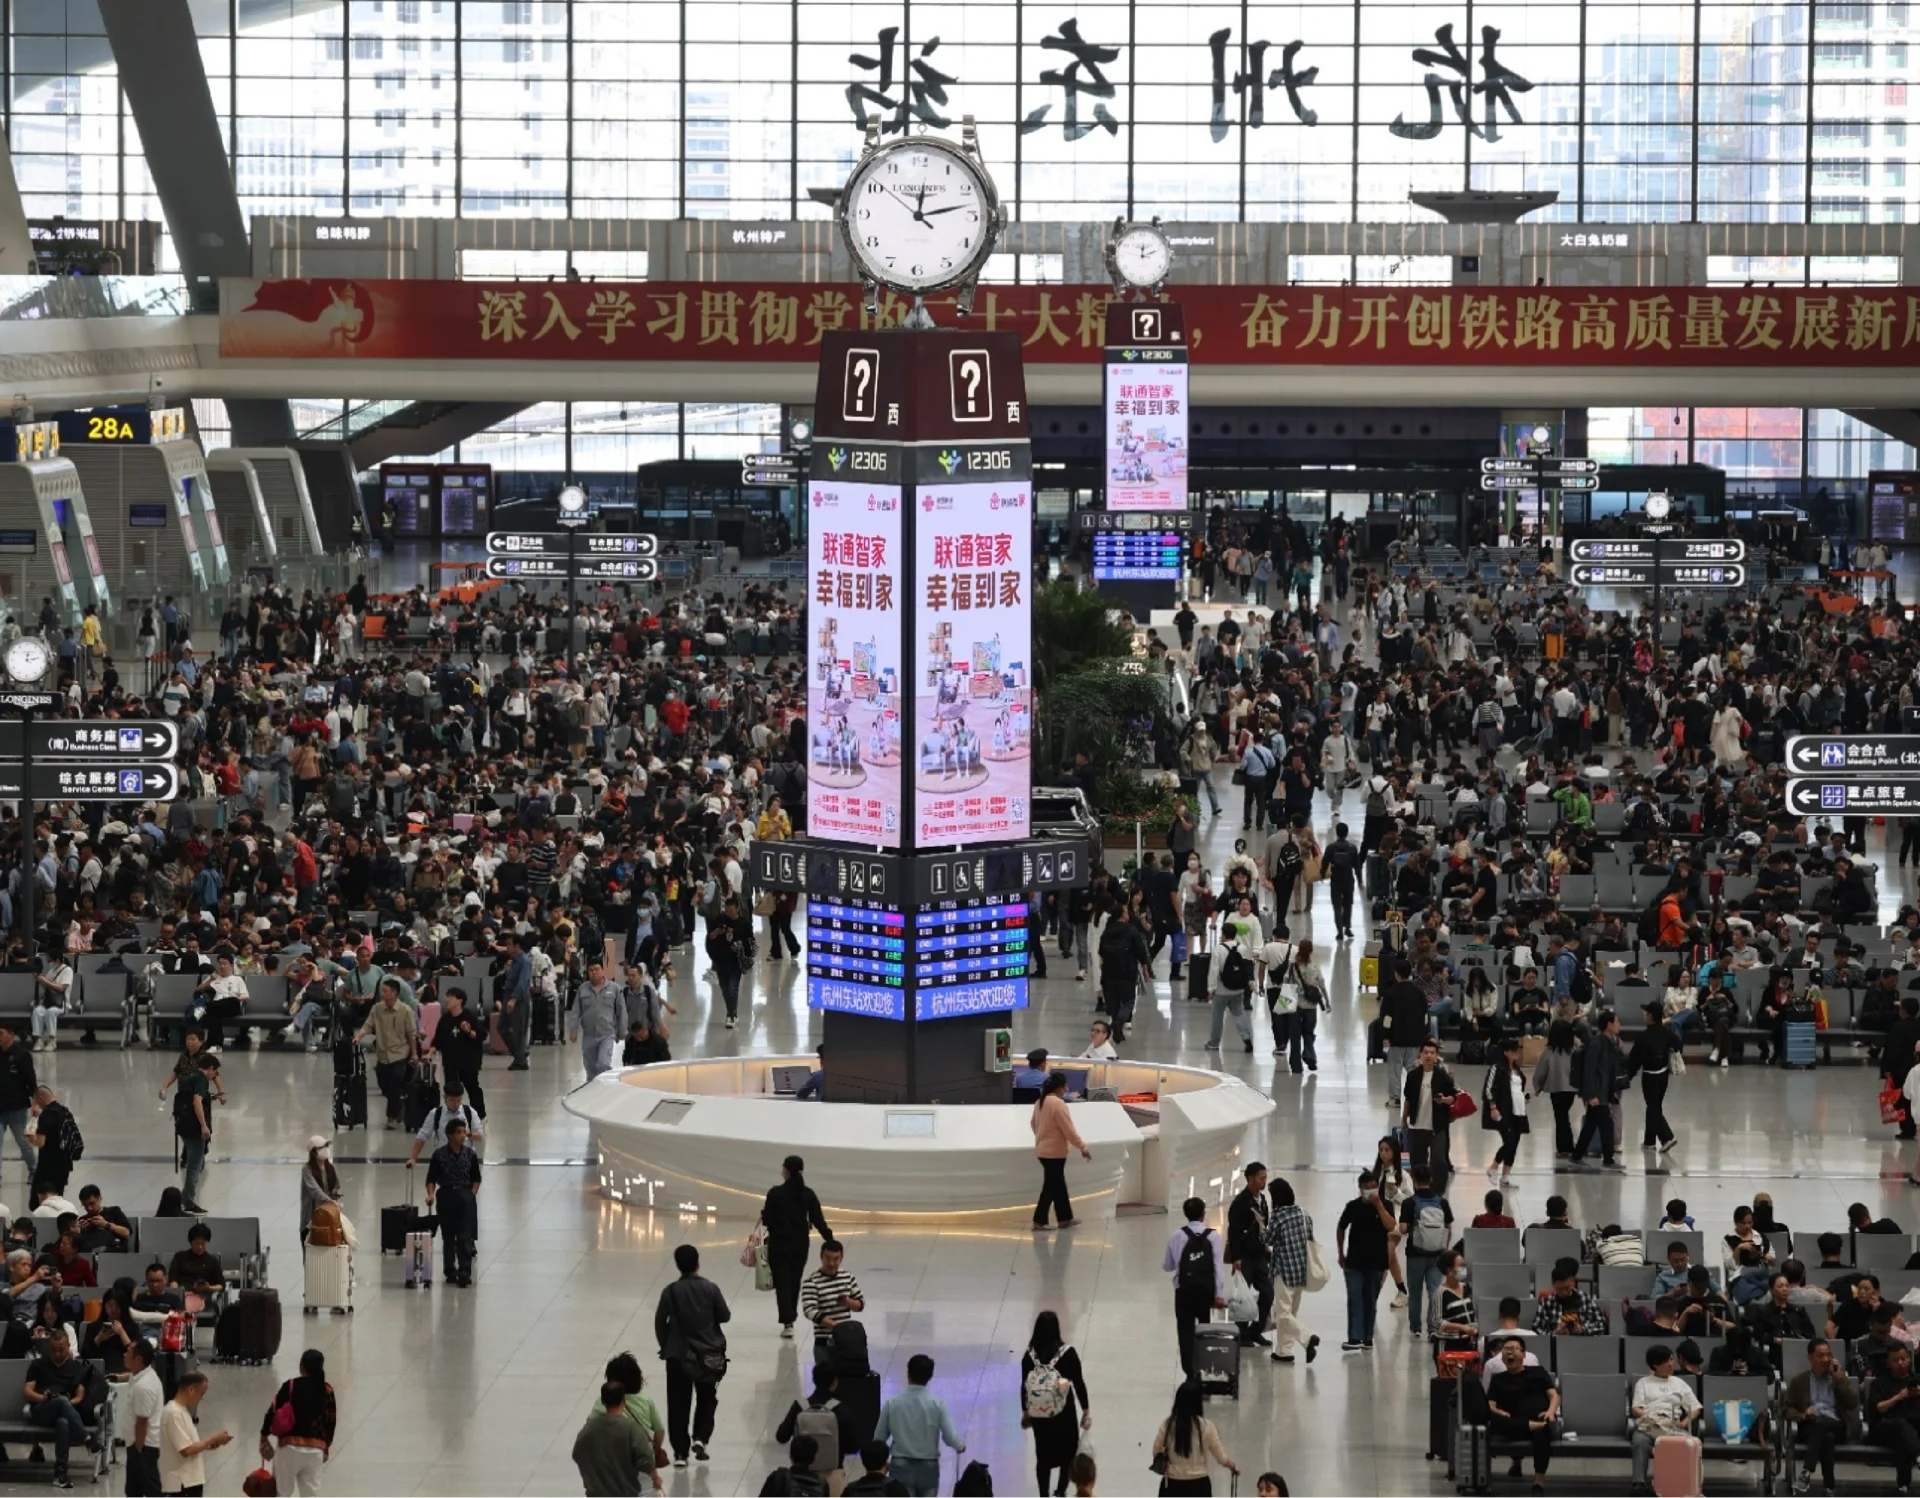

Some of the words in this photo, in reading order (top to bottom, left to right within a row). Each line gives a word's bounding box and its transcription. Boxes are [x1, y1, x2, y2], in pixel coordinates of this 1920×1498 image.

[893, 184, 946, 192] LONGNES
[732, 230, 786, 243] 杭州特产
[1561, 233, 1628, 247] 大白兔奶糖
[1142, 350, 1173, 360] 12306
[1119, 384, 1174, 399] 联通智家
[887, 403, 899, 425] 西
[1007, 401, 1020, 423] 西
[1114, 400, 1180, 415] 幸福到家
[88, 417, 133, 439] 28A
[851, 451, 887, 471] 12306
[967, 451, 1011, 470] 12306
[822, 532, 887, 570] 联通智家
[934, 532, 1012, 570] 联通智家
[816, 569, 893, 611] 幸福到家
[926, 570, 1021, 612] 幸福到家
[0, 695, 52, 704] LONGINES
[75, 729, 117, 743] 商务座
[70, 743, 99, 751] Business
[100, 743, 117, 751] Class
[1847, 744, 1887, 757] 会合点
[1847, 758, 1877, 766] Meeting
[1878, 757, 1898, 765] Point
[59, 772, 117, 785] 综合服务
[1847, 786, 1906, 799] 重点旅客
[821, 983, 894, 1015] 杭州东站欢迎您
[932, 983, 1016, 1015] 杭州东站欢迎您
